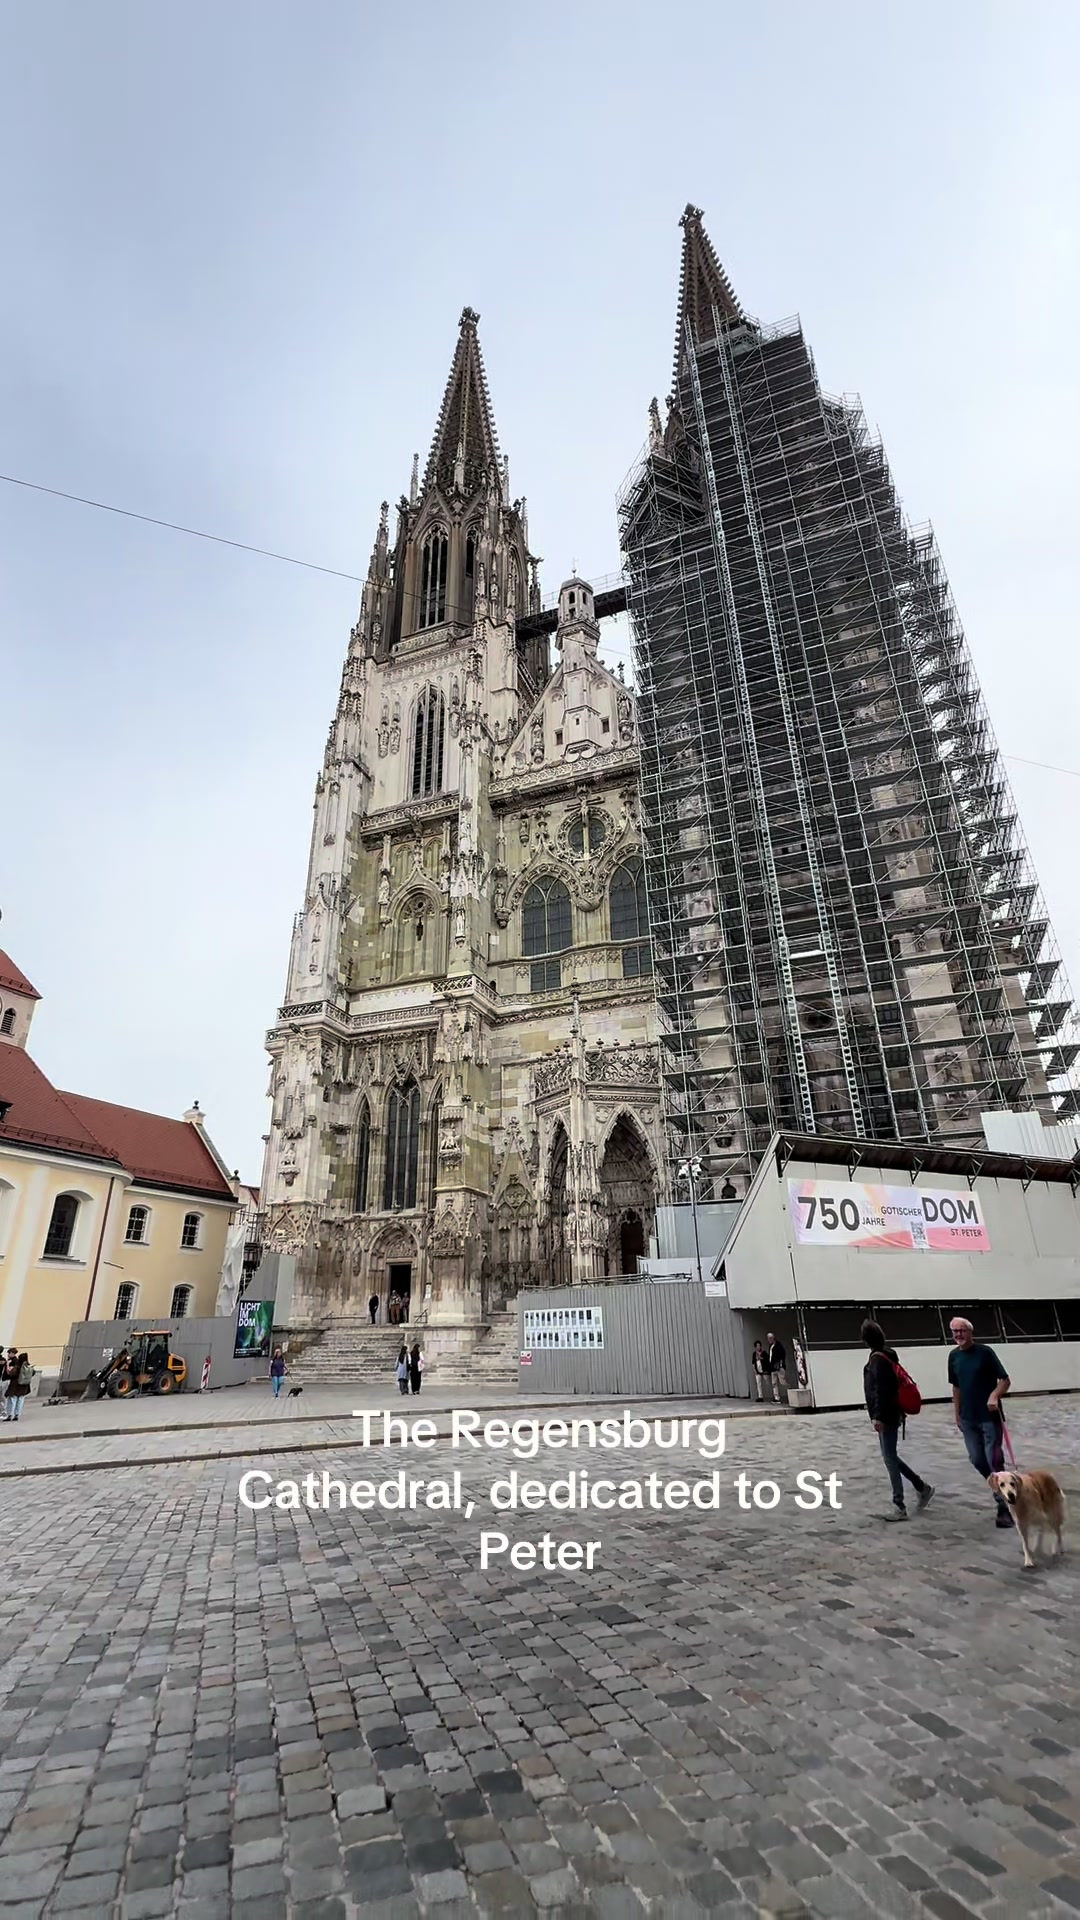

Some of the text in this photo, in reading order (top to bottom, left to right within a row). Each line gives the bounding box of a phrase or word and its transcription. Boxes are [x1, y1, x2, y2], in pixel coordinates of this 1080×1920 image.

[797, 1196, 886, 1231] 750 JAHRE
[880, 1197, 979, 1224] GOTISCHER DOM
[950, 1228, 983, 1237] ST. PETER
[240, 1302, 261, 1311] LICHT
[239, 1310, 249, 1319] IM
[238, 1318, 256, 1327] DOM
